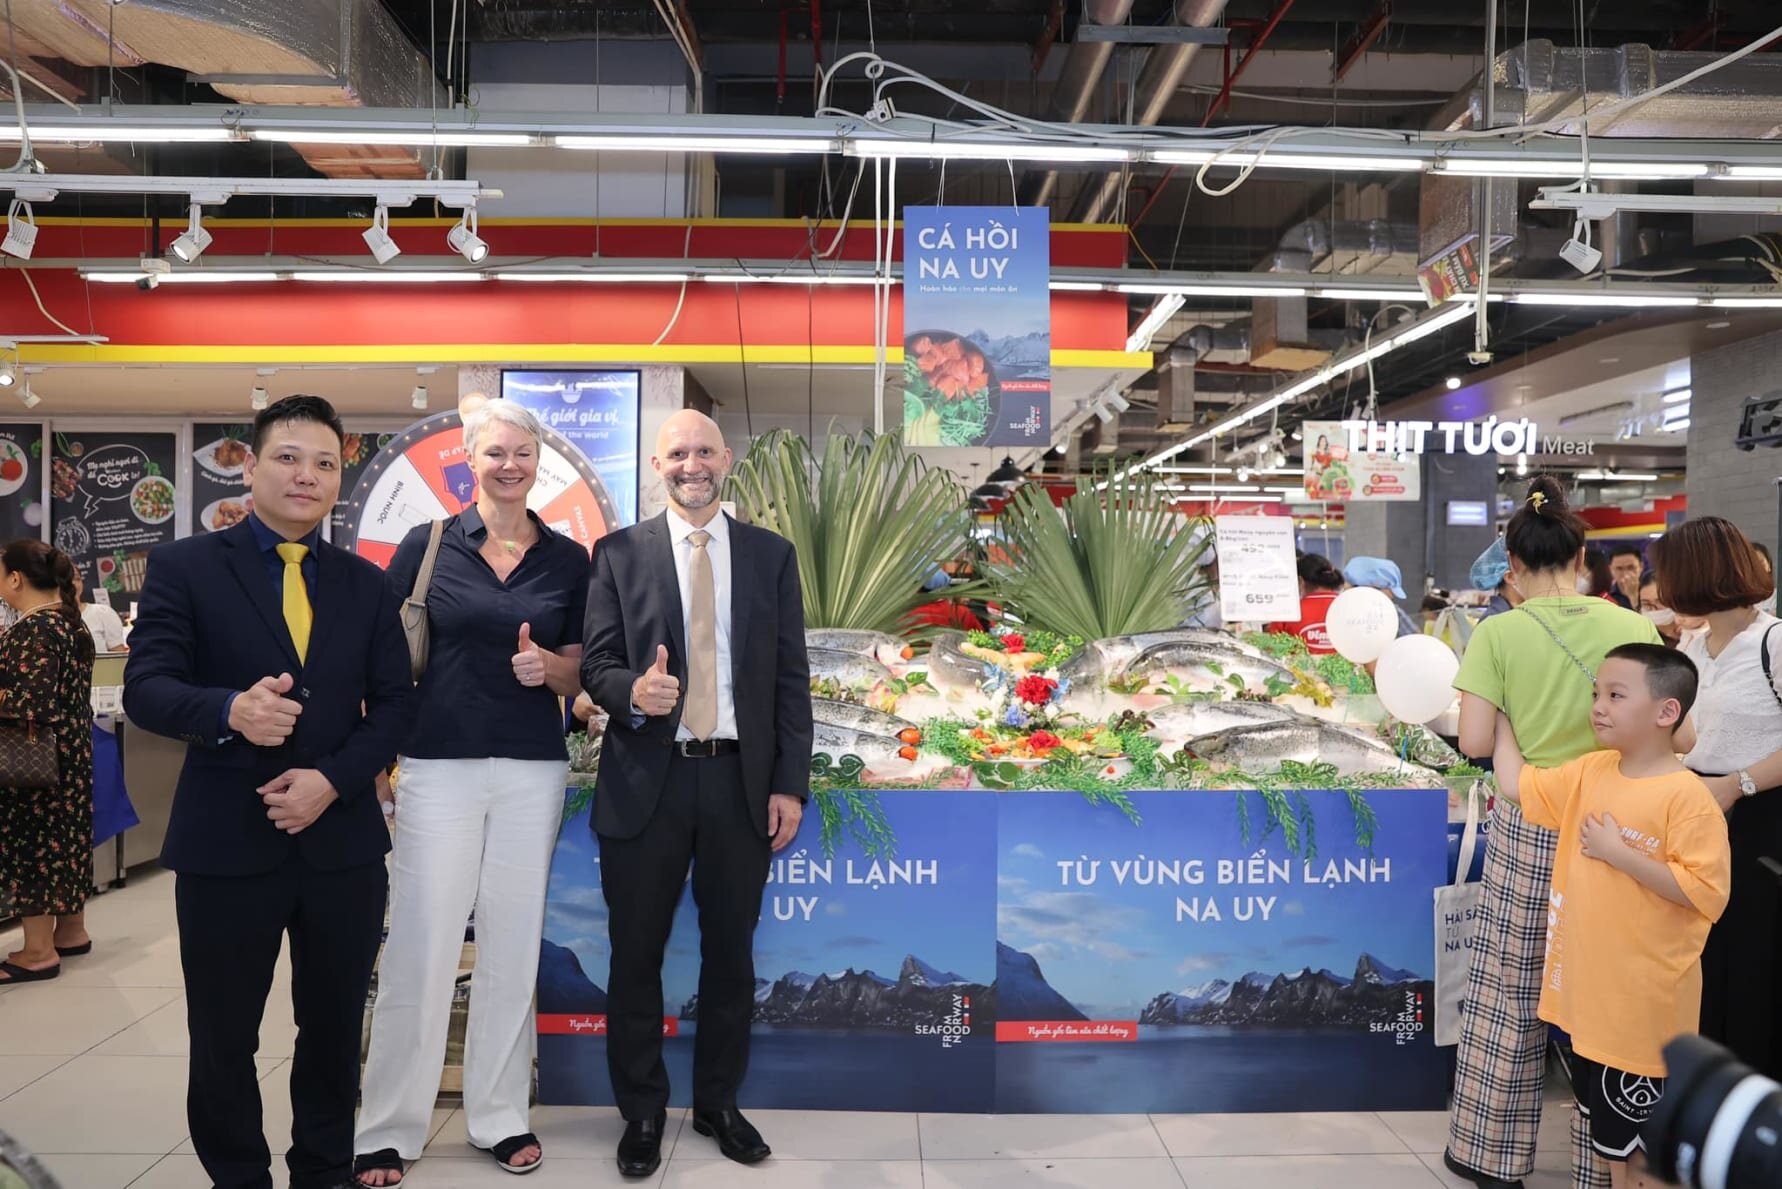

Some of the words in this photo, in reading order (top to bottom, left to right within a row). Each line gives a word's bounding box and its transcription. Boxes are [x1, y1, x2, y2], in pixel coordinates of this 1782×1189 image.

[918, 222, 956, 249] CÁ
[966, 220, 1018, 250] HỒI
[920, 256, 960, 279] NA
[970, 257, 1009, 280] UY
[550, 408, 578, 427] giới
[580, 408, 601, 427] gia
[604, 407, 620, 425] vị
[1341, 420, 1433, 463] THỊT
[1438, 414, 1538, 456] TƯƠI
[1542, 436, 1594, 454] Meat
[1246, 594, 1274, 604] 659
[846, 859, 938, 890] LẠNH
[1057, 854, 1100, 886] TỪ
[1110, 854, 1206, 885] VÙNG
[1216, 849, 1290, 884] BIỂN
[1303, 858, 1391, 888] LẠNH
[774, 896, 818, 920] UY
[1176, 897, 1222, 922] NA
[1233, 896, 1277, 921] UY
[1445, 940, 1460, 952] NA
[1464, 937, 1473, 949] U
[952, 994, 962, 1044] NORWAY
[1370, 1022, 1424, 1032] SEAFOOD
[1396, 1012, 1405, 1045] FROM
[1406, 990, 1415, 1040] NORWAY
[915, 1025, 970, 1034] SEAFOOD
[942, 1014, 952, 1048] FROM
